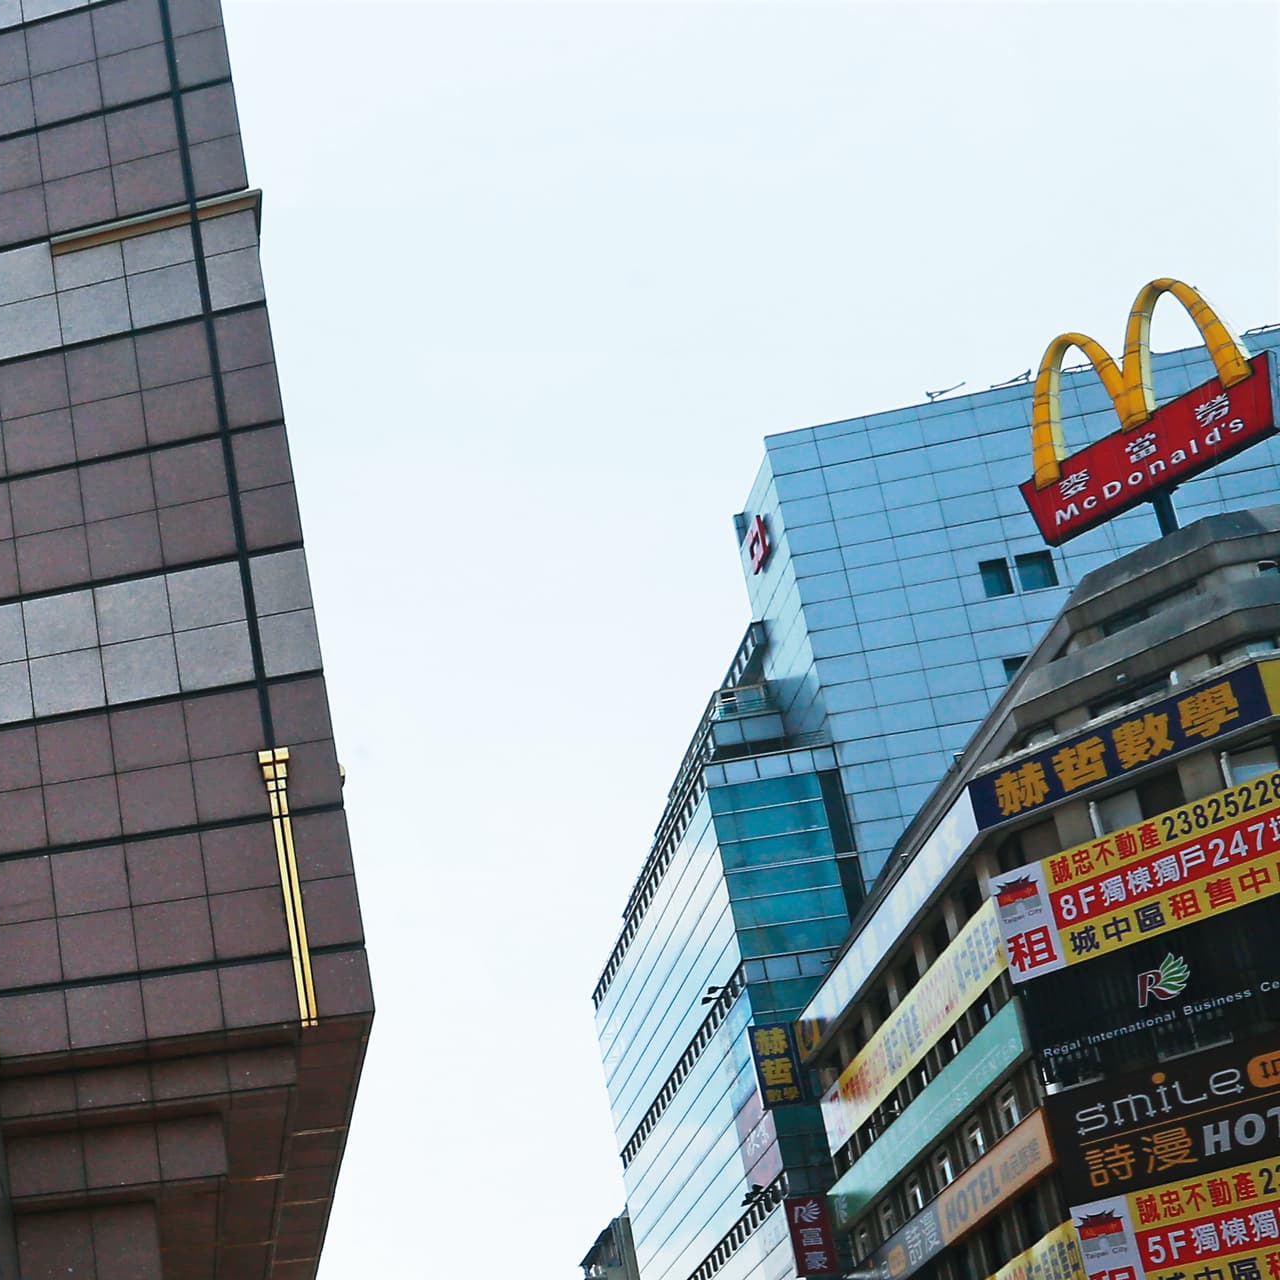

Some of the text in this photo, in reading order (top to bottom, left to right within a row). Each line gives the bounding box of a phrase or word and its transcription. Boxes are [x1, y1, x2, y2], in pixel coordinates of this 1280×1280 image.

[1054, 417, 1245, 526] McDonald's
[1058, 392, 1231, 500] 麥當勞
[994, 681, 1240, 817] 赫哲數學
[1050, 773, 1280, 885] 誠忠不動產 23825228
[1070, 863, 1280, 955] 城中區租售中
[1007, 925, 1057, 974] 租
[753, 1027, 793, 1086] 赫哲
[1043, 1039, 1081, 1059] Regal
[1088, 1010, 1177, 1046] International
[1183, 988, 1252, 1016] Business
[1085, 1126, 1199, 1187] 詩漫
[1136, 1172, 1258, 1225] 誠忠不動產
[802, 1227, 831, 1271] 富豪
[1148, 1207, 1280, 1264] 5F獨棟獨
